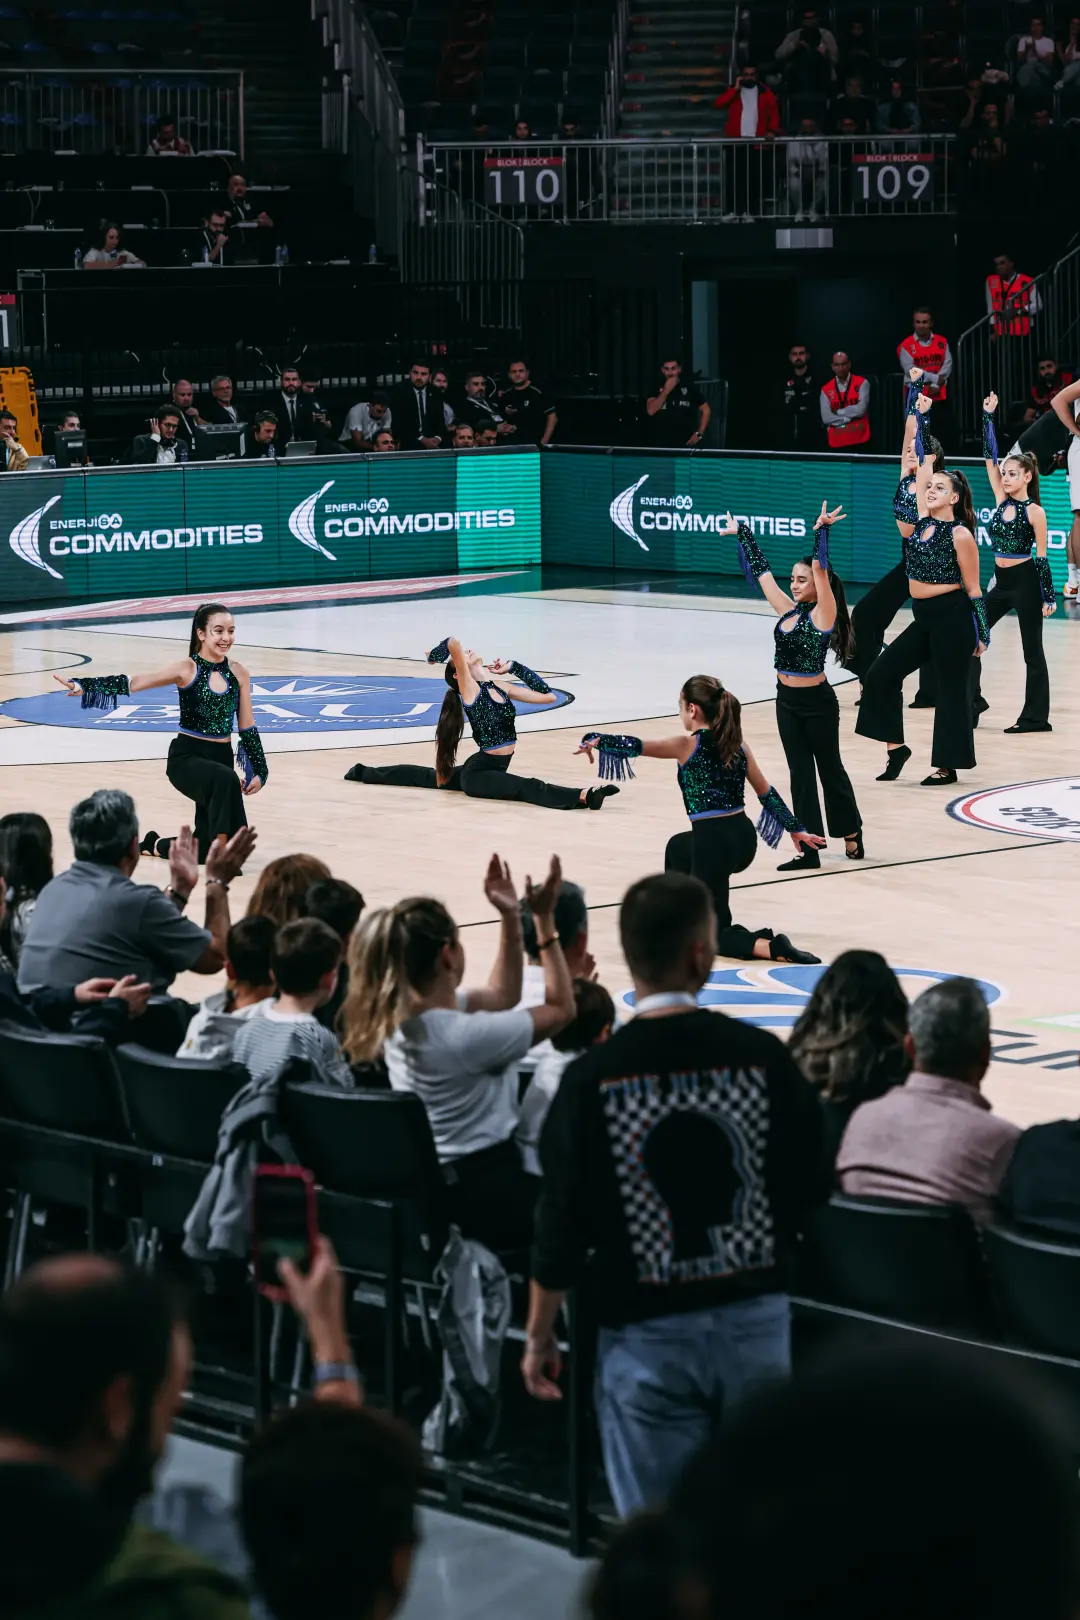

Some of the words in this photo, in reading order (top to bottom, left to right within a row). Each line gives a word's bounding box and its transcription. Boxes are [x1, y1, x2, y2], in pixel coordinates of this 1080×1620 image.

[497, 159, 517, 167] BLOK
[523, 158, 549, 166] BLOCK
[489, 169, 559, 204] 110
[857, 165, 930, 200] 109
[49, 523, 264, 556] COMMODITIES
[324, 508, 515, 539] COMMODITIES
